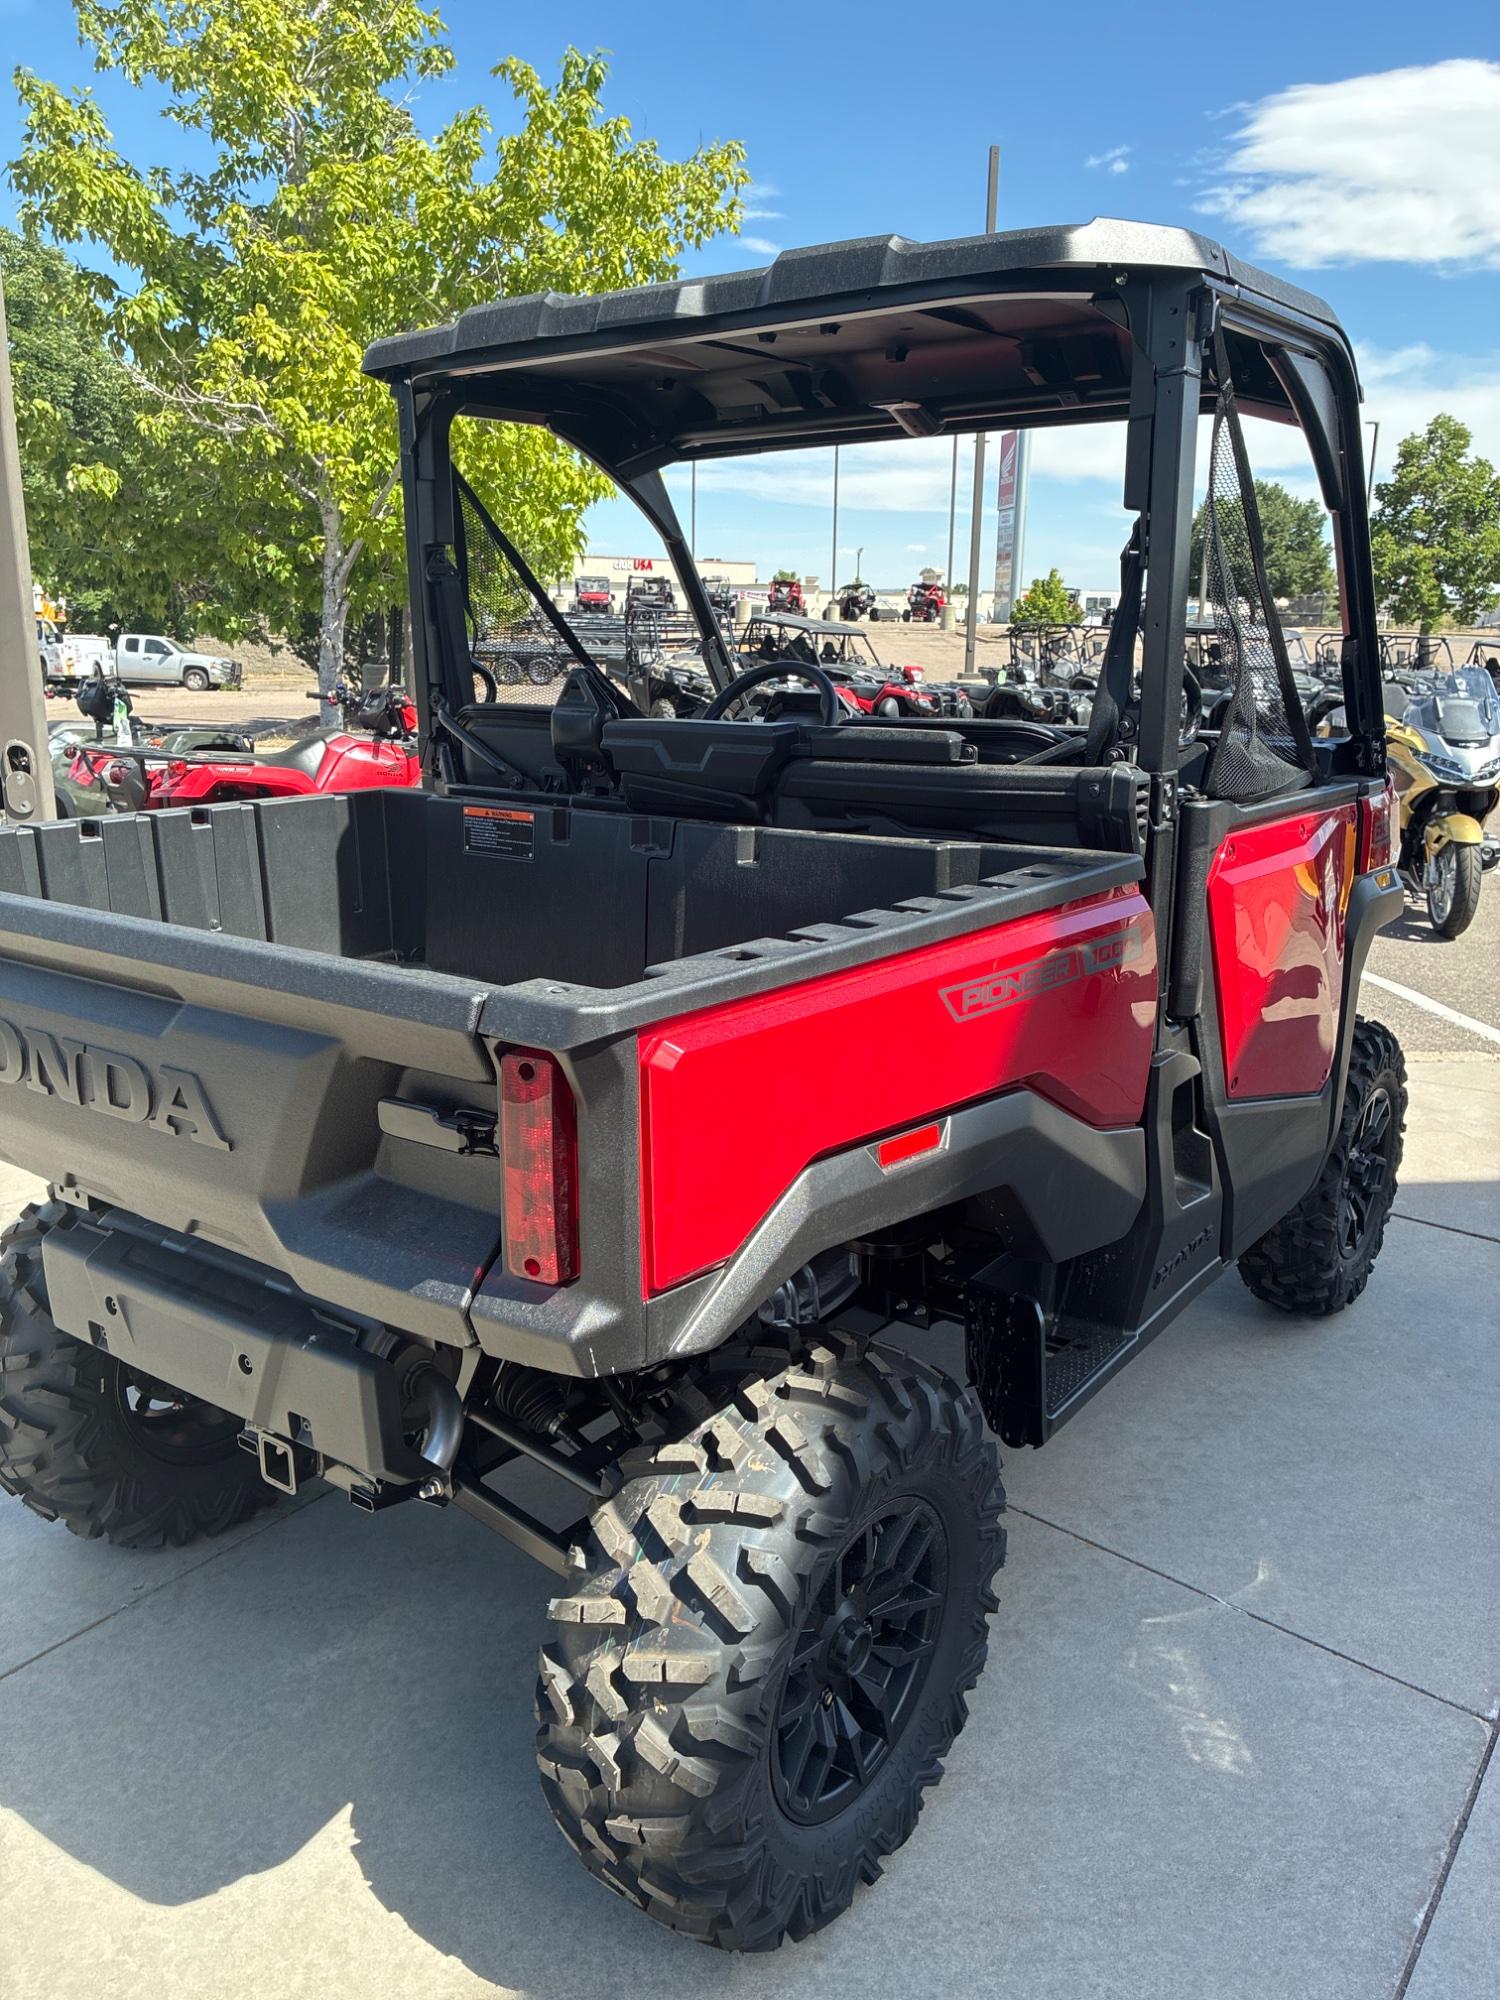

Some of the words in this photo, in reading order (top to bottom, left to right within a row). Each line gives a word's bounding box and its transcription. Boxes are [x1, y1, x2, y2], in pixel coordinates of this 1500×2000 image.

[633, 559, 653, 571] USA
[962, 959, 1074, 1013] PIONEER
[1153, 1225, 1217, 1290] HONDA
